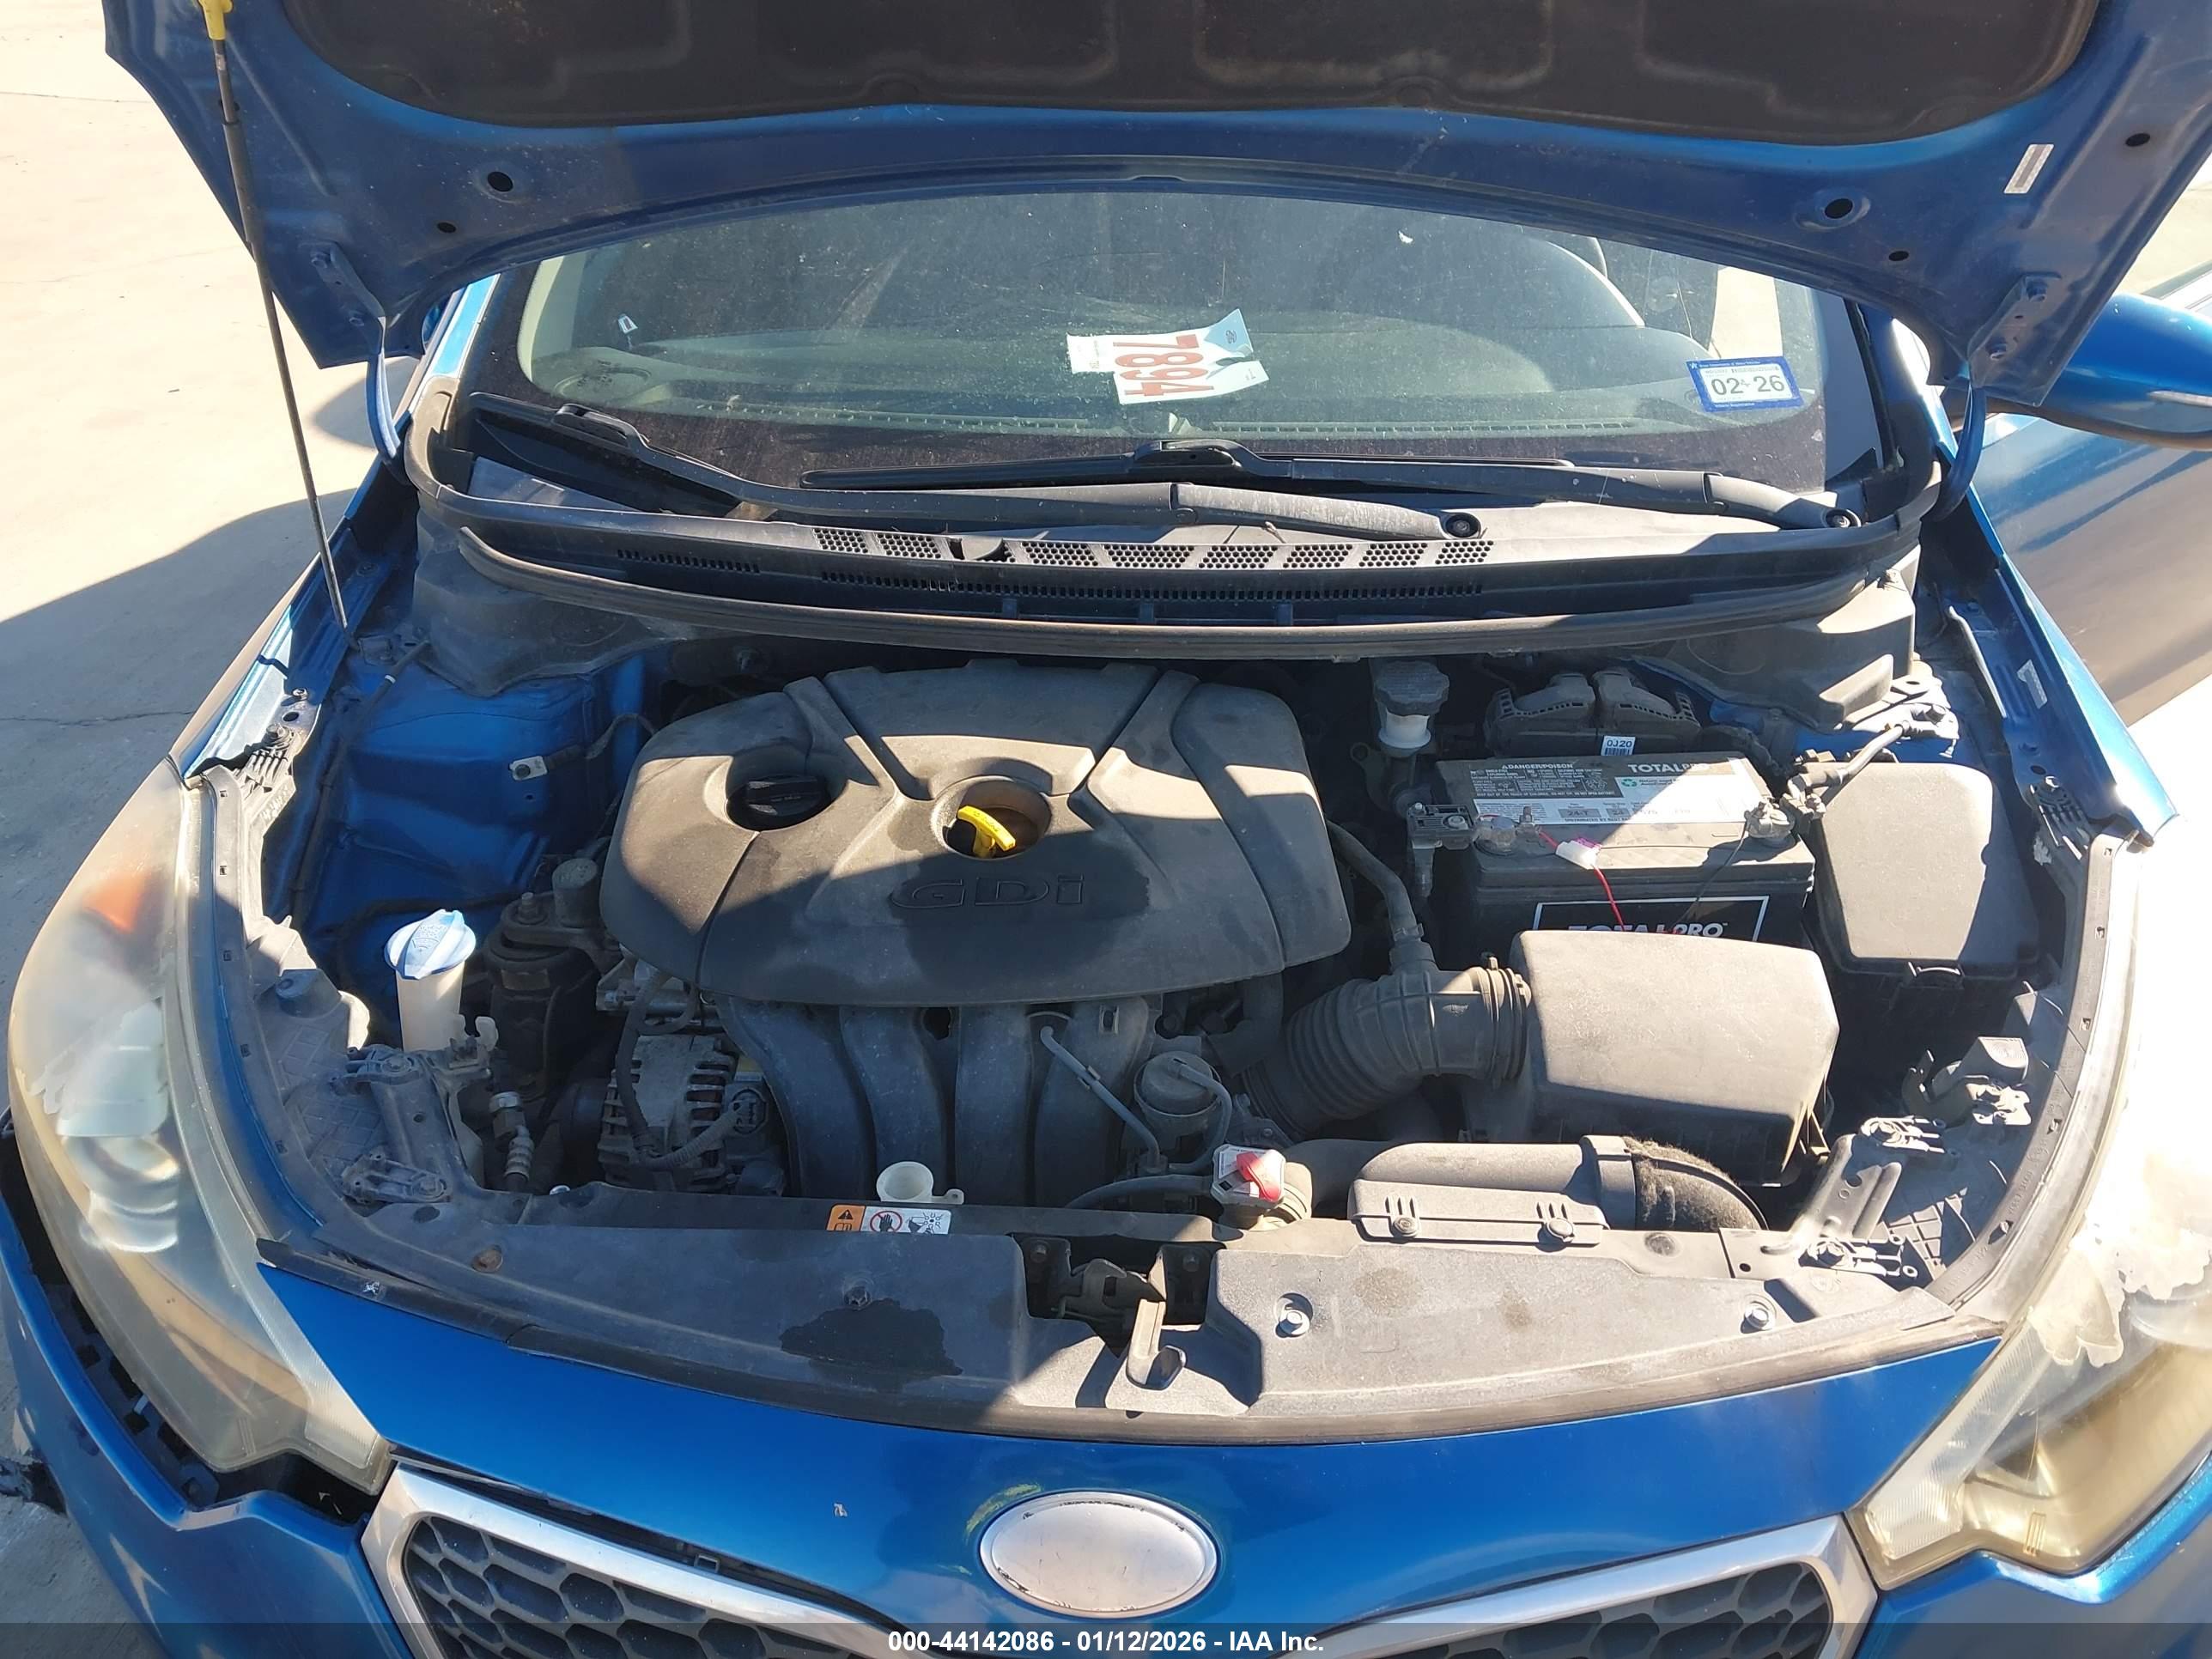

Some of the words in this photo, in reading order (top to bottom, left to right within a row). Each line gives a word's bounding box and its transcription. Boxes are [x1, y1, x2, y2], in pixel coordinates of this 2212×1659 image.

[1113, 334, 1214, 397] 7894
[1711, 378, 1744, 396] 02
[1753, 375, 1785, 392] 26
[1628, 763, 1709, 773] TOTALPR
[887, 872, 1085, 908] GDi
